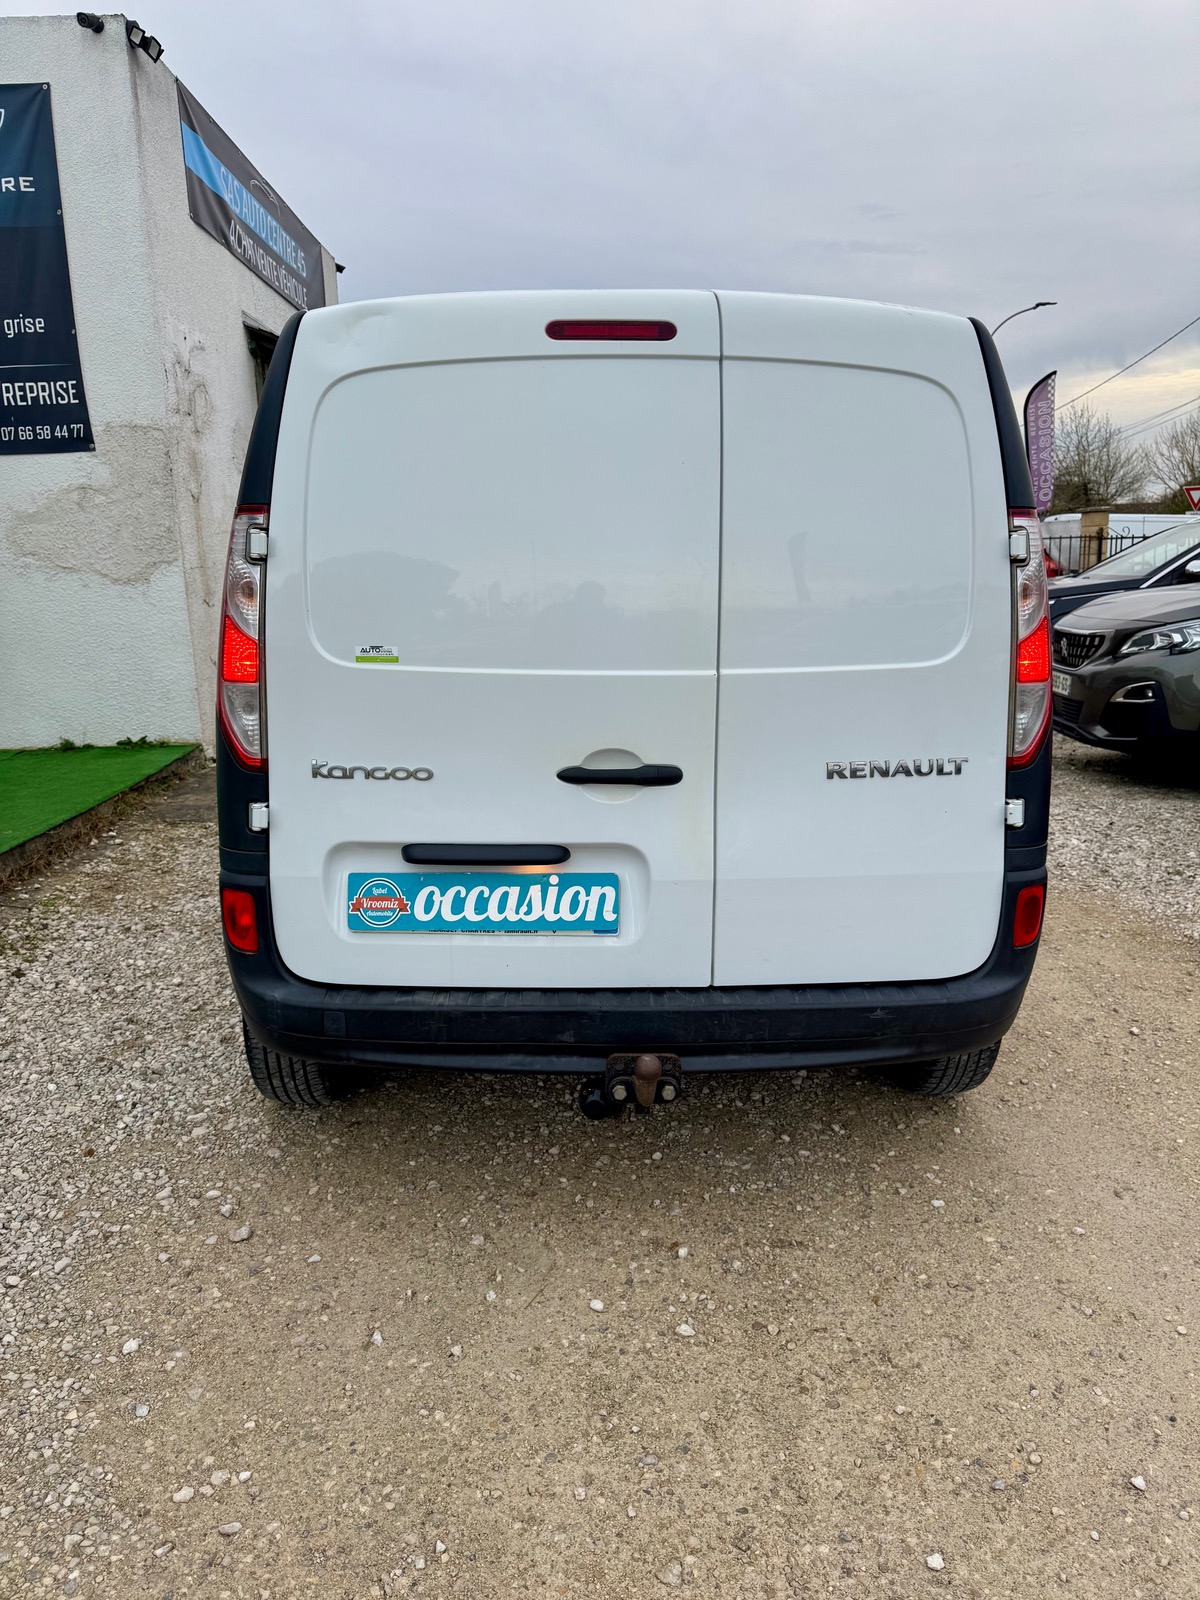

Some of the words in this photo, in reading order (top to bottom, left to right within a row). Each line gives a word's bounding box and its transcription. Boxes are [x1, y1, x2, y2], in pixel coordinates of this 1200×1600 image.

[220, 166, 241, 214] SAS
[4, 313, 45, 338] grise
[1, 380, 79, 406] REPRISE
[1, 426, 15, 441] 07
[18, 426, 33, 440] 66
[36, 425, 51, 439] 58
[54, 424, 68, 439] 44
[70, 423, 84, 438] 77
[1038, 400, 1052, 502] OCCASION
[360, 645, 381, 653] AUTO
[825, 757, 969, 780] RENAULT
[360, 898, 399, 909] Vroomiz
[372, 887, 388, 896] Label
[414, 874, 618, 922] occasion
